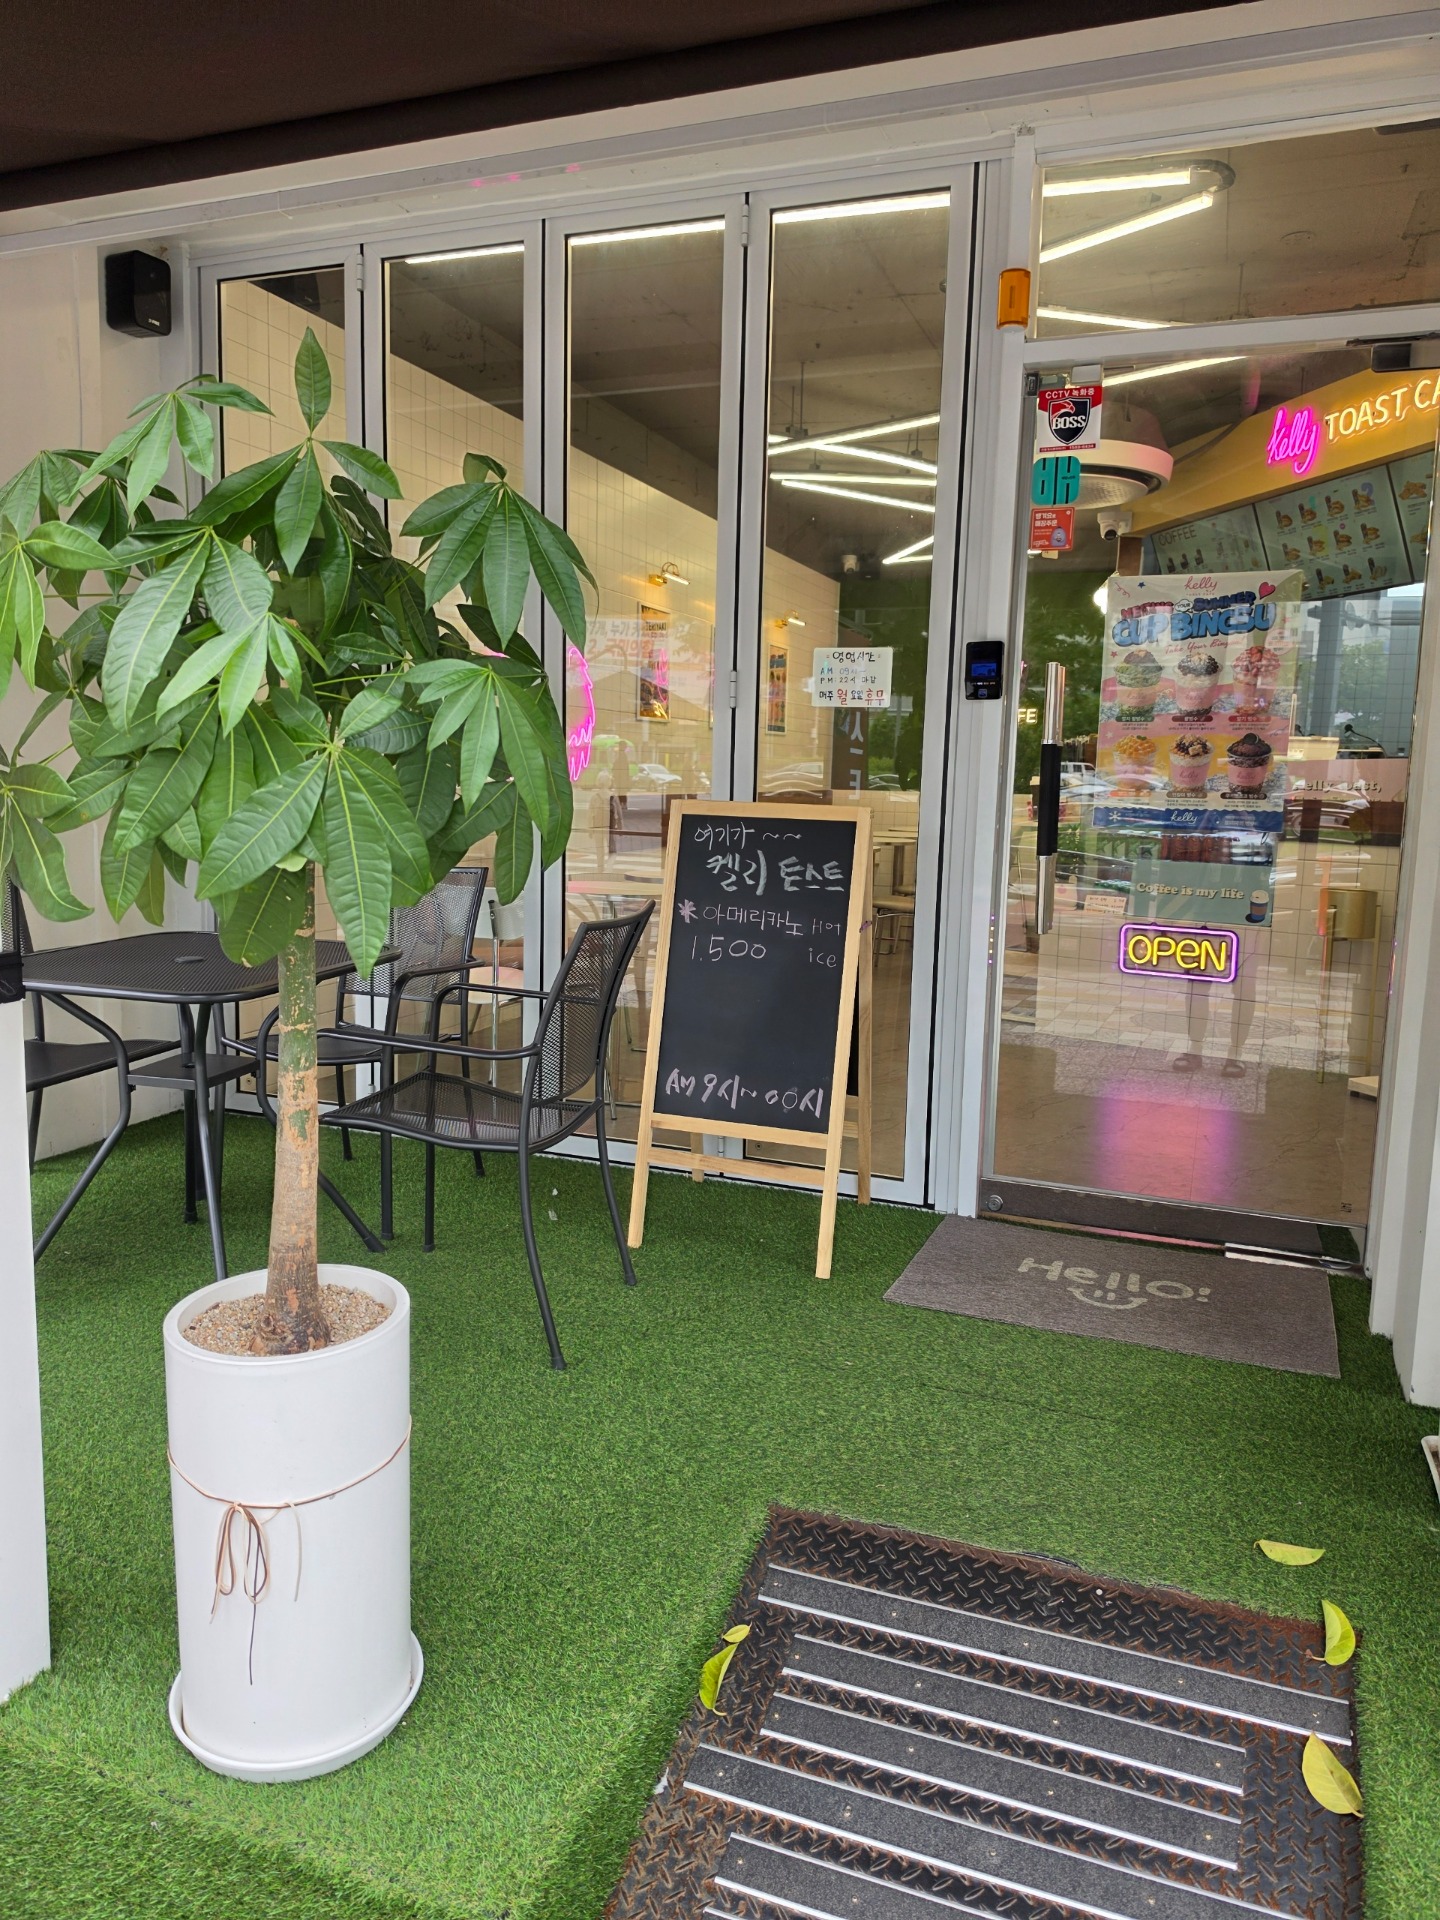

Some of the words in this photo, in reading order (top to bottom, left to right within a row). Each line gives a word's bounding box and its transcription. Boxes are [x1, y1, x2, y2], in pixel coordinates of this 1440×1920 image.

[1045, 389, 1070, 399] CCTV
[1072, 388, 1095, 396] 녹화중
[1053, 415, 1087, 430] BOSS
[1267, 407, 1319, 475] kelly
[1324, 387, 1408, 441] TOAST
[1158, 525, 1198, 547] COFFEE
[1184, 575, 1218, 591] kelly
[1193, 590, 1257, 612] SUMMER
[1112, 610, 1170, 647] CUP
[1187, 641, 1207, 652] Your
[832, 651, 876, 664] 영업시간
[1170, 811, 1199, 825] kelly
[694, 821, 755, 850] 여기가
[706, 849, 768, 896] 켈리
[1136, 882, 1178, 896] Coffee
[1181, 885, 1193, 896] is
[1195, 889, 1216, 900] my
[1221, 888, 1245, 900] life
[702, 903, 804, 936] 아메리카노
[808, 947, 838, 968] ice
[665, 1067, 696, 1098] AM
